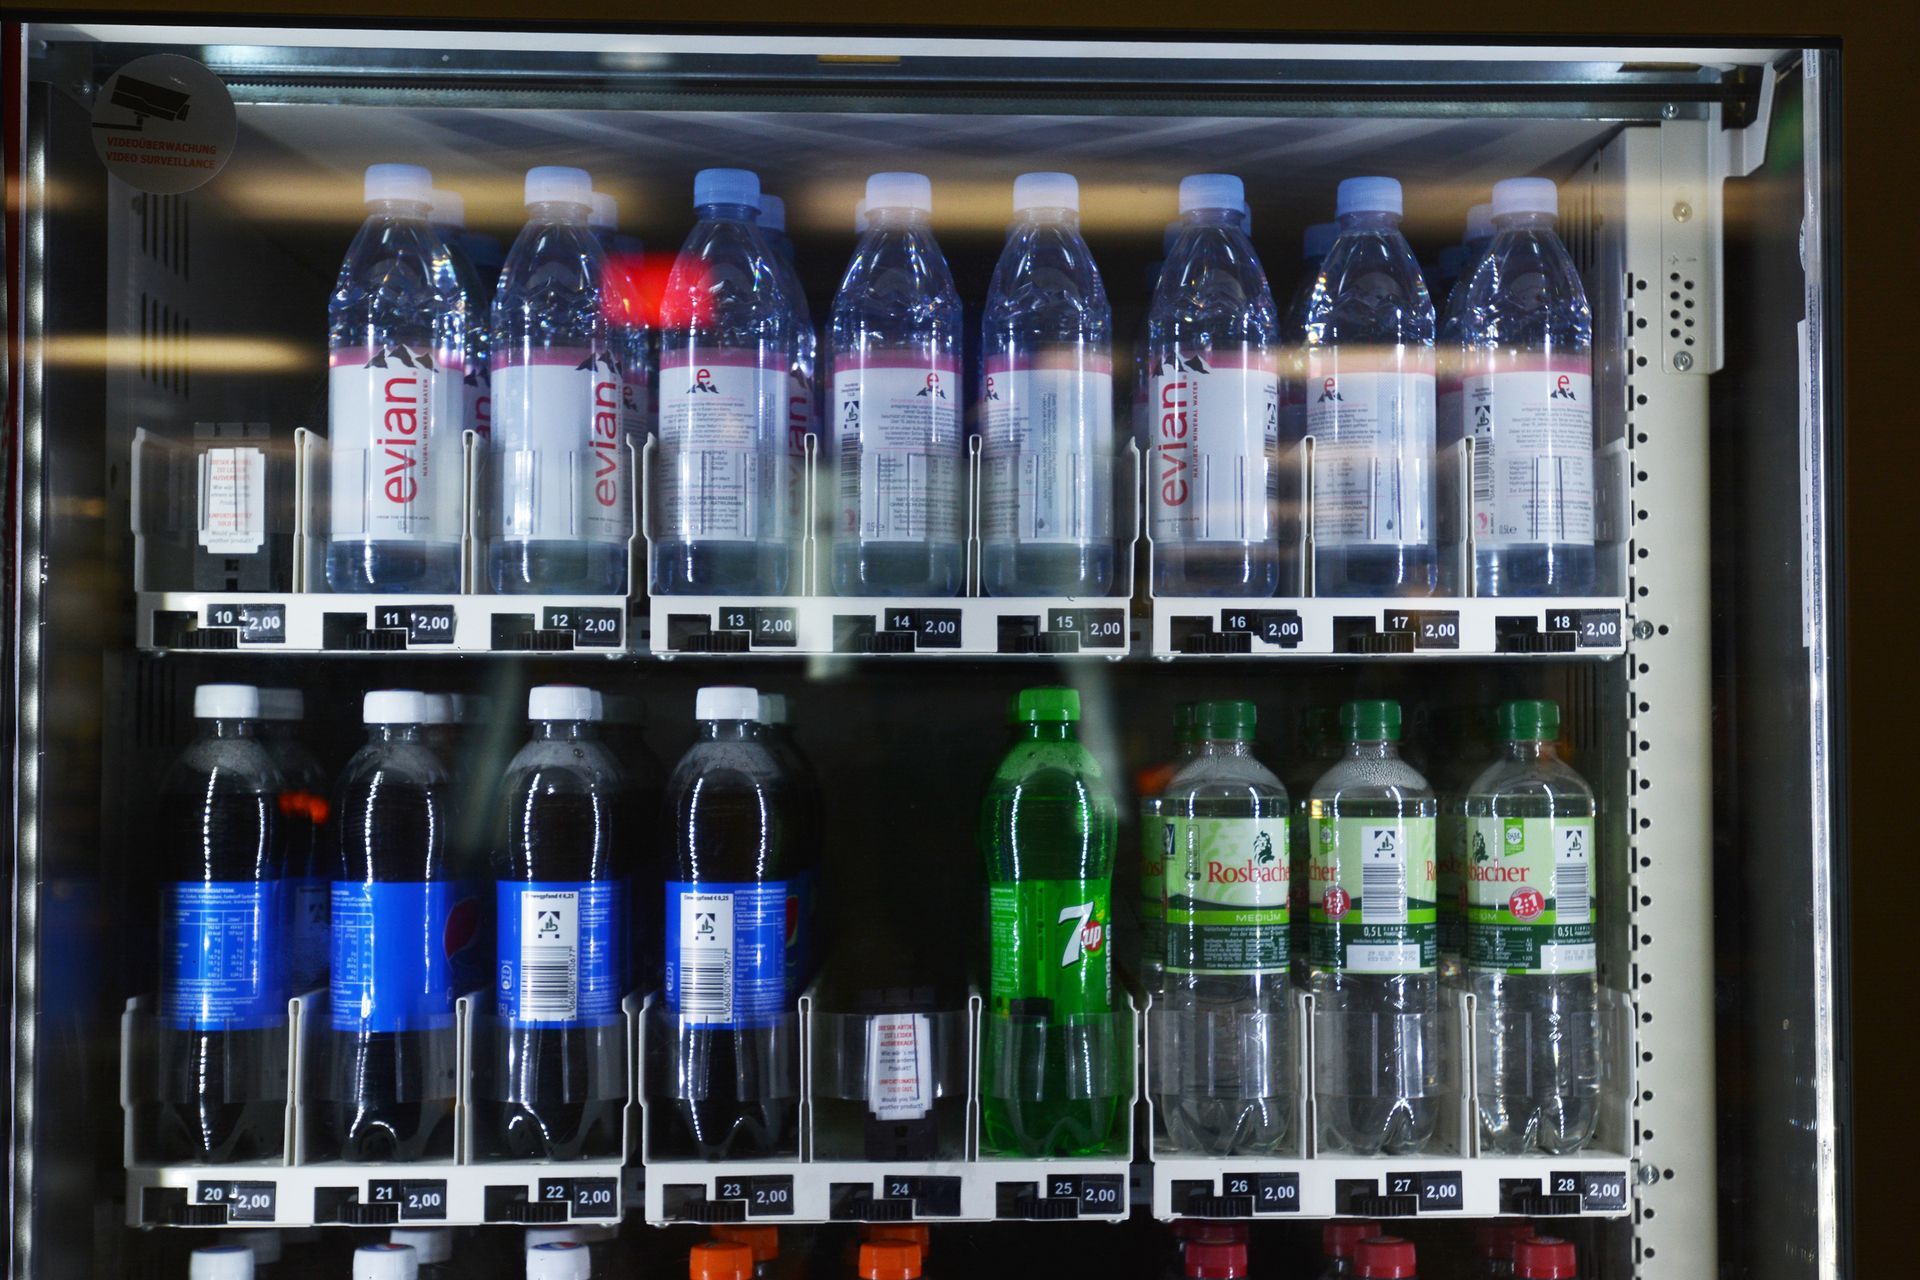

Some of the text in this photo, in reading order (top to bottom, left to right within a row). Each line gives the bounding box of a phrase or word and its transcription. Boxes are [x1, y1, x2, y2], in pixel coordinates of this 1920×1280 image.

[106, 137, 217, 154] VIDEOÜBERWACHUNG
[106, 151, 217, 169] VIDEO SURVEILLANCE
[376, 377, 418, 504] evian
[588, 381, 617, 508] evian
[1158, 381, 1189, 507] evian
[214, 611, 281, 631] 10 2,00
[383, 612, 450, 631] 11 2,00
[550, 614, 616, 633] 12 2,00
[727, 614, 793, 633] 13 2,00
[892, 616, 956, 635] 14 2,00
[1055, 616, 1121, 637] 15 2,00
[1229, 615, 1299, 638] 16 2,00
[1391, 616, 1456, 639] 17 2,00
[1553, 616, 1617, 638] 18 2,00
[1468, 858, 1530, 883] bacher
[1513, 894, 1539, 911] 2:1
[1236, 913, 1282, 922] MEDIUM
[203, 1187, 270, 1210] 20 2,00
[375, 1187, 441, 1209] 21 2,00
[545, 1185, 611, 1205] 22 2,00
[723, 1184, 788, 1204] 23 2,00
[891, 1183, 909, 1196] 24
[1055, 1182, 1116, 1203] 25 2,00
[1230, 1179, 1295, 1201] 26 2,00
[1394, 1179, 1457, 1200] 27 2,00
[1557, 1178, 1621, 1200] 28 2,00
